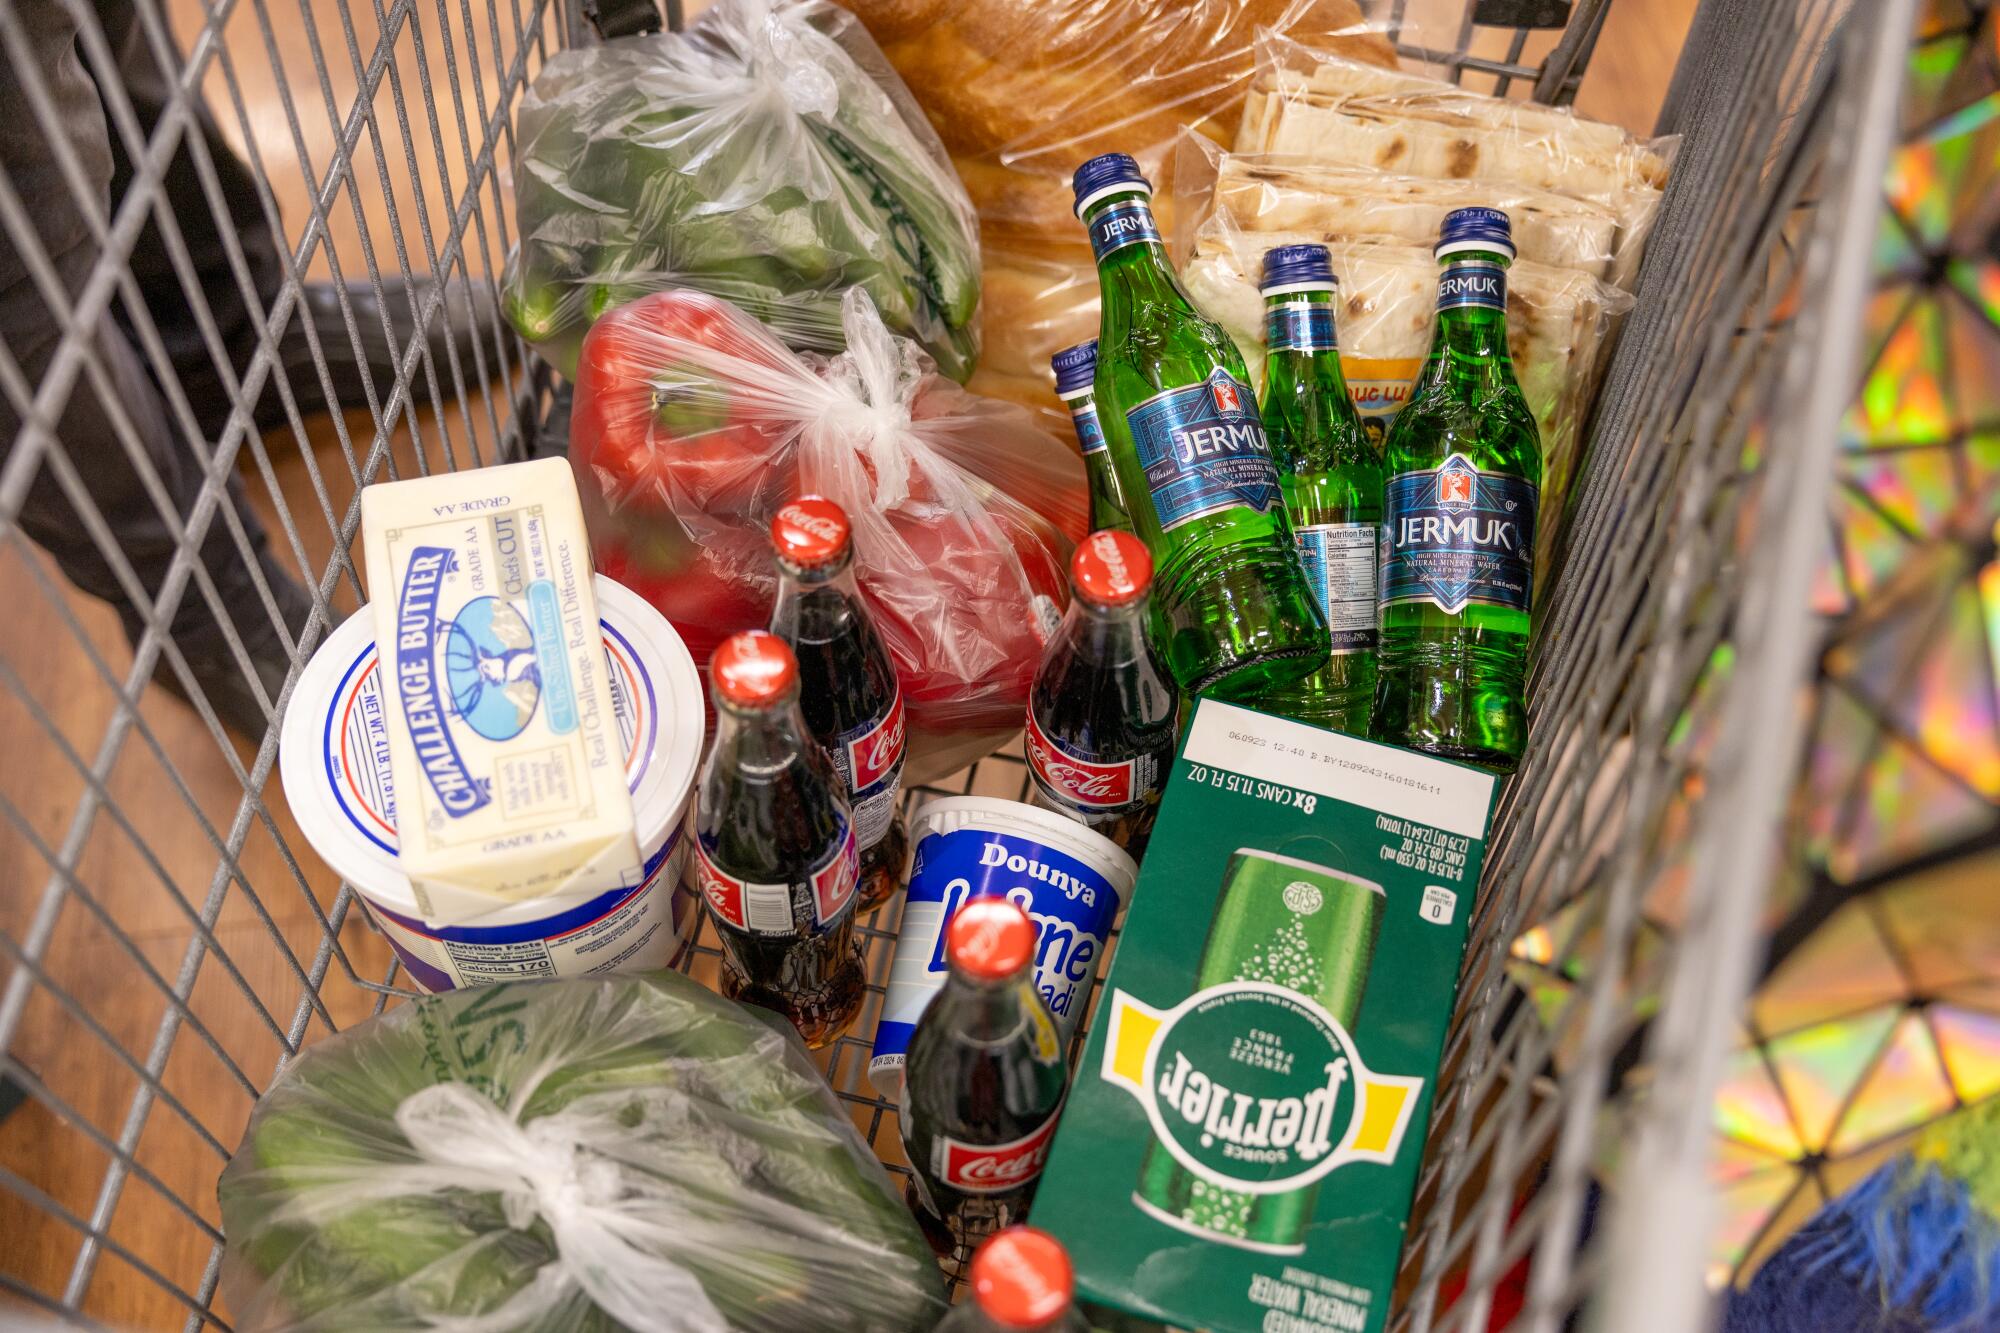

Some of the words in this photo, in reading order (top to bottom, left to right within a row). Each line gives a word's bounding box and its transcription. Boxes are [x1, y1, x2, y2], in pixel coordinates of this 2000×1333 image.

[1103, 215, 1156, 242] JERMU
[1436, 277, 1498, 301] JERMUK
[1229, 459, 1252, 467] MINERAL
[1150, 467, 1176, 482] Classic
[1204, 467, 1236, 478] NATURAL
[433, 505, 457, 517] AA
[461, 495, 511, 513] GRADE
[465, 526, 479, 544] AA
[494, 517, 518, 555] CUT
[1327, 530, 1357, 539] Nutrition
[1358, 529, 1374, 537] Facts
[1396, 516, 1512, 550] JERMUK
[1328, 552, 1347, 561] Calories
[1460, 553, 1489, 562] CONTENT
[1477, 561, 1500, 570] WATER
[467, 546, 485, 591] GRADE
[557, 539, 581, 614] Difference.
[400, 553, 444, 651] BUTTER
[539, 601, 554, 641] Butter
[565, 616, 587, 650] Real
[577, 651, 602, 733] Challenge.
[364, 694, 381, 716] NET
[370, 718, 385, 739] WT.
[401, 659, 477, 811] CHALLENGE
[586, 736, 608, 769] Real
[1228, 731, 1266, 747] 060923
[1273, 742, 1304, 757] 12:40
[377, 752, 391, 769] LB.
[1187, 765, 1208, 783] OZ
[1211, 770, 1225, 787] FL
[1226, 775, 1255, 796] 11.15
[1257, 783, 1292, 804] CANS
[1293, 792, 1317, 815] 8x
[1375, 814, 1402, 835] TOTAL)
[481, 834, 537, 854] GRADE
[542, 828, 567, 844] AA
[1411, 826, 1433, 843] [2.64
[1380, 844, 1397, 861] mL)
[1401, 837, 1413, 852] OZ
[1414, 841, 1423, 856] FL
[1422, 844, 1445, 862] (89.2
[1447, 837, 1469, 854] [2.79
[1396, 851, 1416, 867] (330
[1414, 857, 1427, 871] OZ
[1427, 859, 1437, 874] FL
[1444, 850, 1466, 867] CANS
[979, 842, 1097, 909] Dounya
[1437, 862, 1464, 882] 8-11.15
[1432, 904, 1440, 919] 0
[446, 942, 502, 951] Nutrition
[506, 941, 541, 951] Facts
[456, 962, 514, 972] Calories
[517, 959, 547, 971] 170
[1198, 997, 1225, 1013] France
[1224, 994, 1235, 1003] in
[1235, 992, 1264, 1004] Source
[1265, 994, 1281, 1005] the
[1290, 1002, 1324, 1032] Captured
[1249, 1028, 1282, 1047] 1863
[1233, 1036, 1294, 1063] FRANCE
[1158, 1050, 1348, 1160] perrier
[1223, 1143, 1288, 1163] SOURCE
[1248, 1273, 1301, 1315] WATER
[1302, 1289, 1369, 1333] MINERAL
